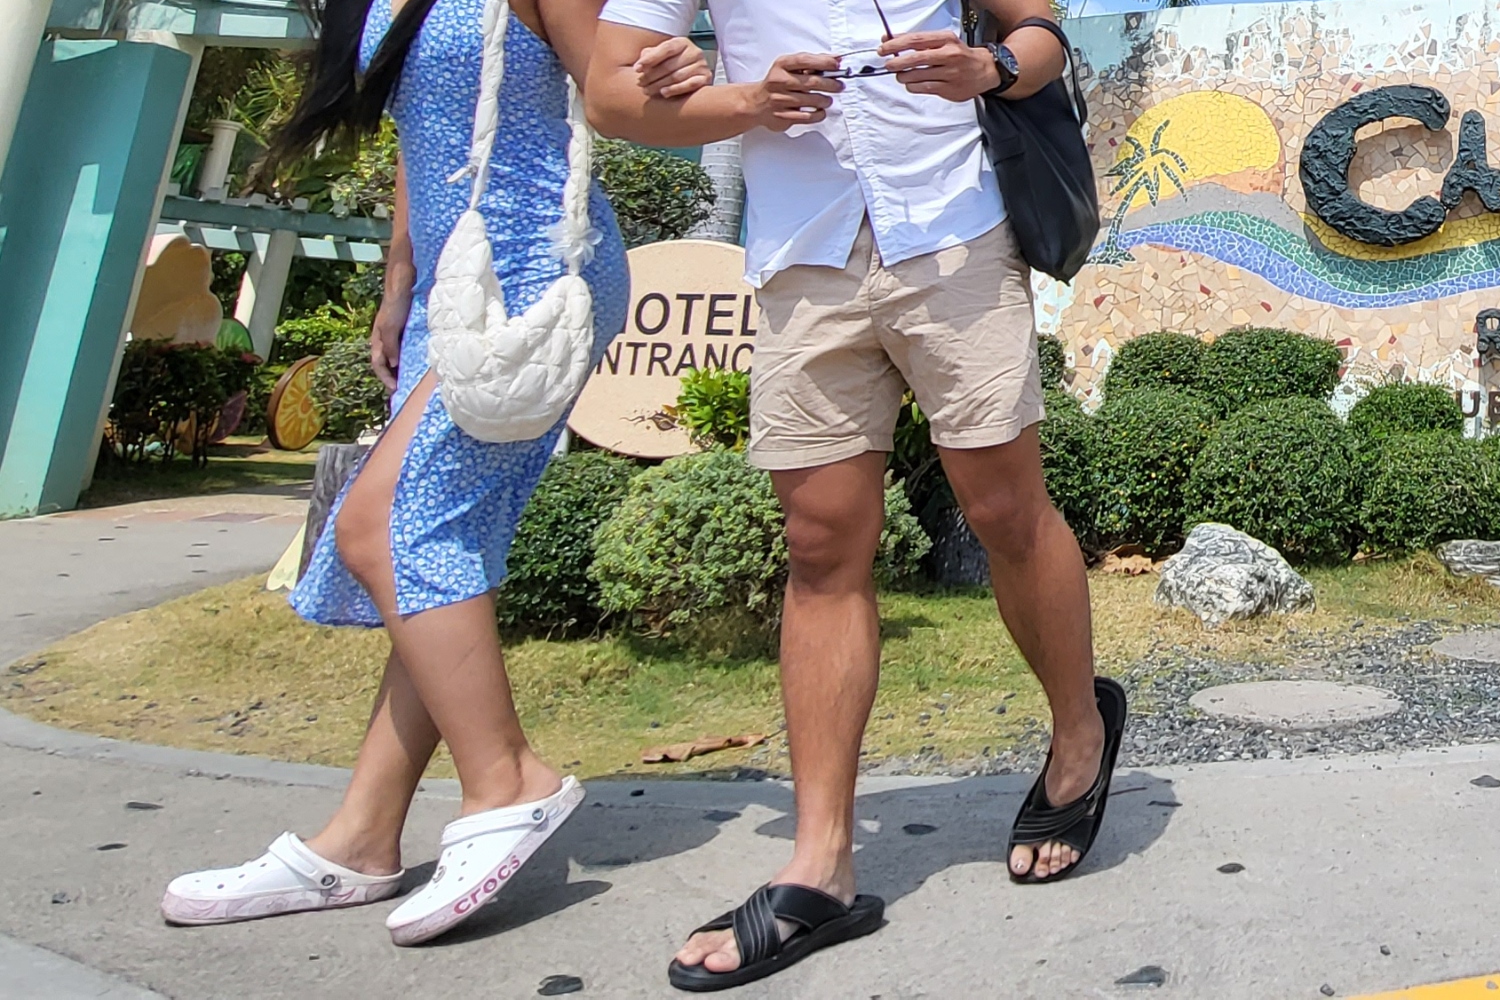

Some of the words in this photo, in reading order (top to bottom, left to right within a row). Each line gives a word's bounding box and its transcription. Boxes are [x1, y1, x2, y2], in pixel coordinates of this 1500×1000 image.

[622, 292, 757, 337] OTEL
[596, 341, 755, 377] NTRANC
[453, 855, 521, 914] crocs
